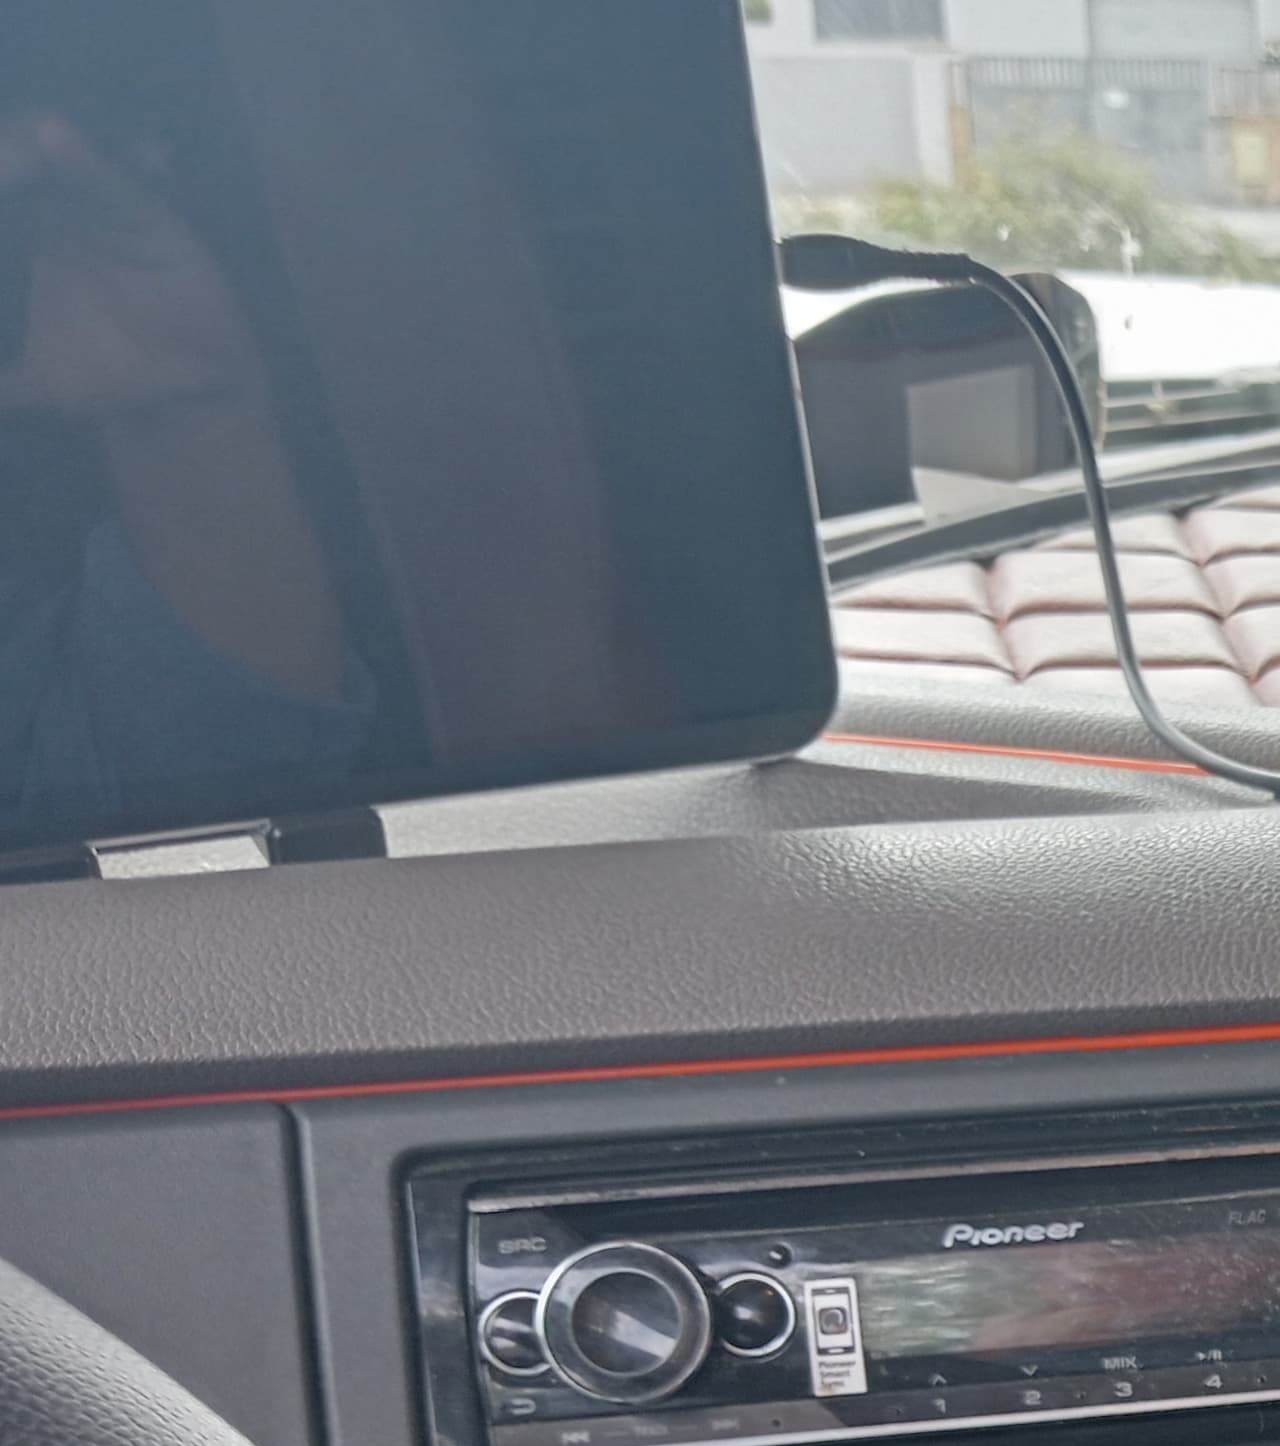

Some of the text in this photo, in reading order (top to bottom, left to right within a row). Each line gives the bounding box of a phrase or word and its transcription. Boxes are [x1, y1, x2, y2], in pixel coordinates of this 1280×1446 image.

[943, 1222, 1085, 1249] Pioneer
[1113, 1380, 1134, 1398] 3
[1203, 1373, 1223, 1389] 4
[1023, 1389, 1042, 1406] 2
